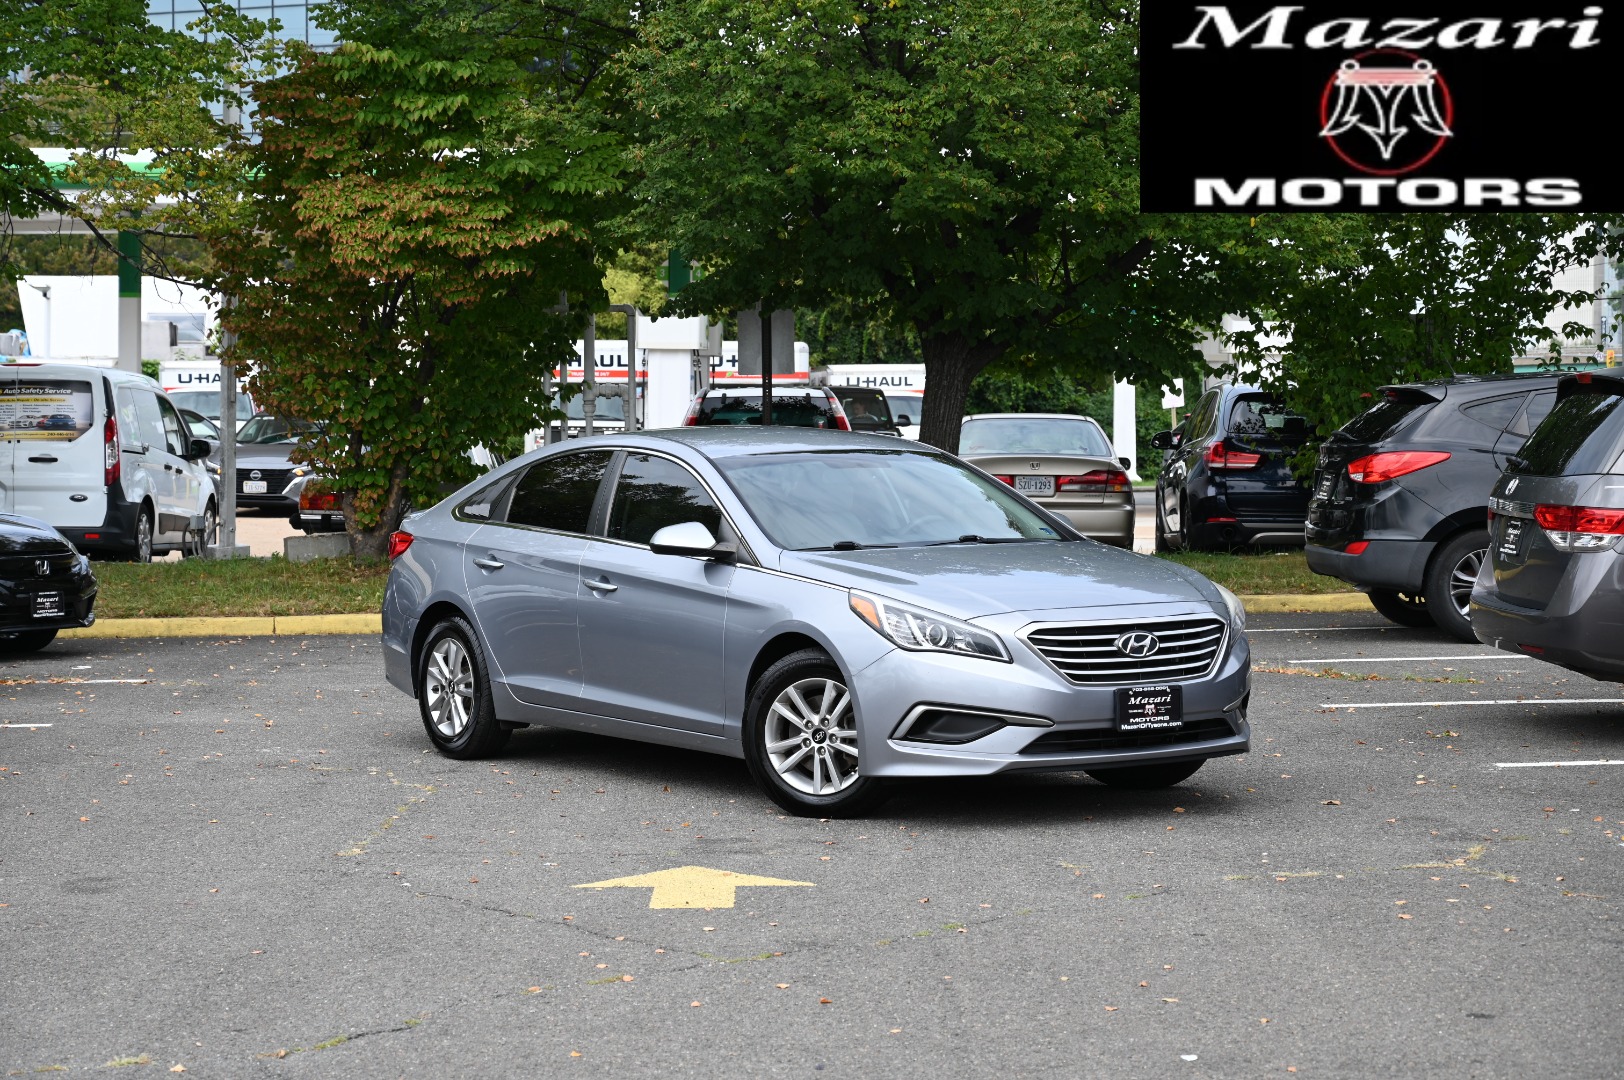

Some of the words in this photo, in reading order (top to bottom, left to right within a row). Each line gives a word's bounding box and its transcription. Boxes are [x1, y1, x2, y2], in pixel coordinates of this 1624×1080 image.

[177, 373, 247, 383] U-HAL
[846, 376, 913, 387] U-HAUL
[21, 387, 43, 395] Safety
[1018, 481, 1052, 490] SZU-1293
[1128, 695, 1171, 704] Mazari
